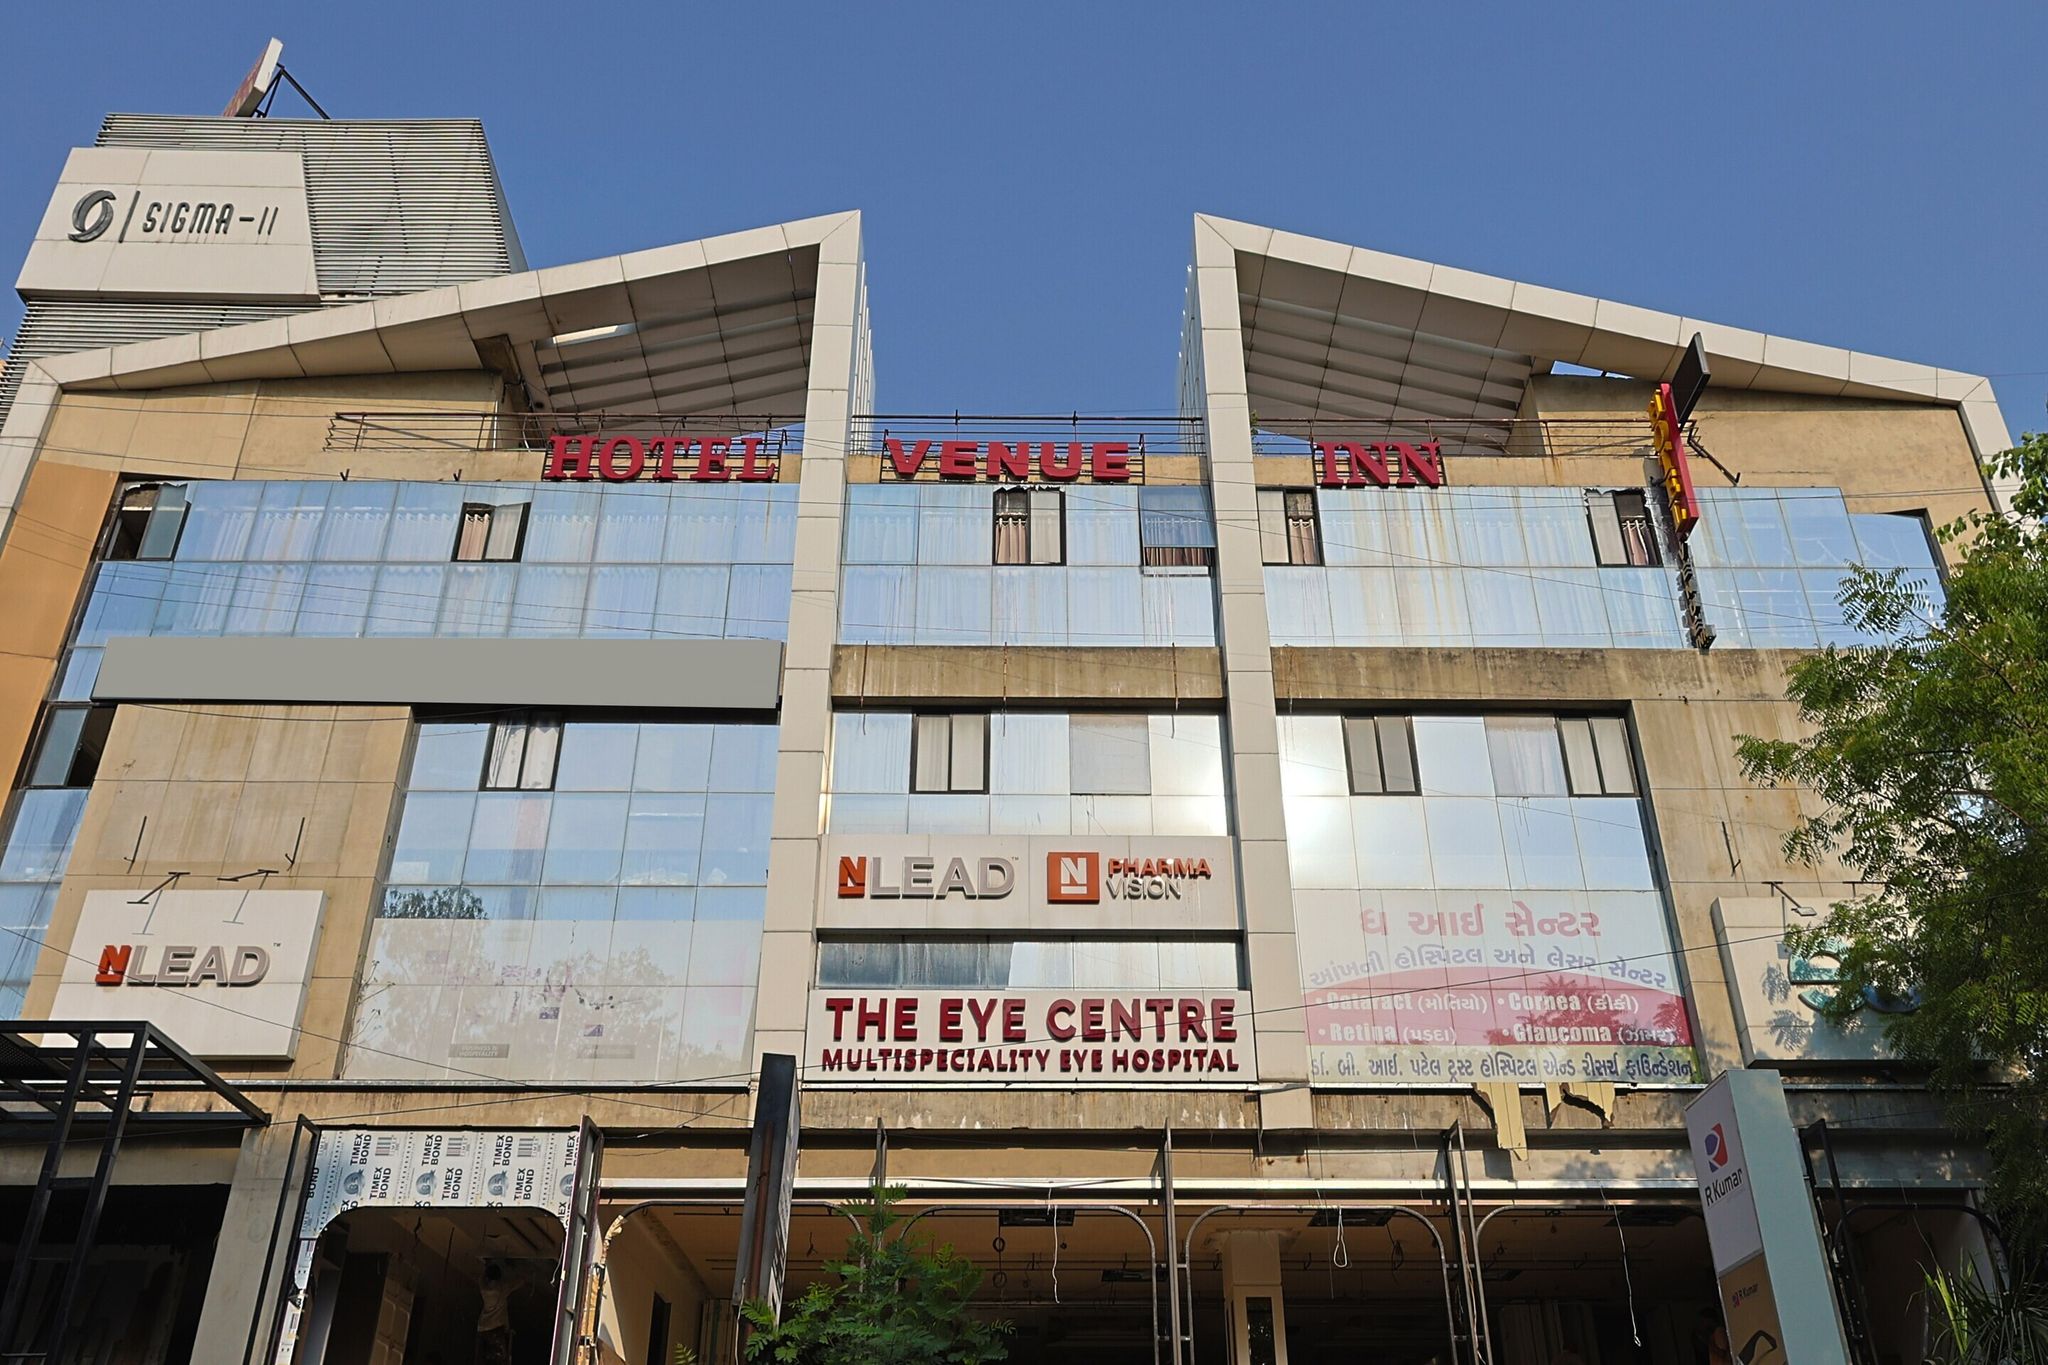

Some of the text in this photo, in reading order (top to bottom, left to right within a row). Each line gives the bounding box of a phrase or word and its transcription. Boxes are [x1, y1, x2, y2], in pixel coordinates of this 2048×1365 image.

[544, 434, 1441, 488] HOTEL VENUE INN
[837, 856, 1017, 901] NLEAD
[1108, 858, 1212, 880] PHARMA
[1106, 876, 1182, 900] VISION
[1408, 902, 1484, 937] આઈ
[1504, 900, 1602, 937] સેન્ટર
[95, 945, 271, 987] NLEAD
[1394, 943, 1483, 969] હોસ્પિટલ
[1494, 943, 1536, 965] અને
[1608, 956, 1667, 988] સેન્ટર
[1327, 991, 1414, 1010] Cataract
[1508, 992, 1581, 1011] Cornea
[826, 997, 1238, 1043] THE EYE CENTRE
[1330, 1023, 1398, 1041] Retina
[1513, 1022, 1612, 1042] Glaucoma
[822, 1047, 1239, 1073] MULTISPECIALITY EYE HOSPITAL
[1410, 1051, 1441, 1076] પટેલ
[1480, 1051, 1537, 1077] હોસ્પિટલ
[350, 1133, 363, 1167] TIMEX
[359, 1134, 372, 1165] BOND
[422, 1134, 434, 1166] TIMEX
[431, 1135, 443, 1165] BOND
[493, 1135, 505, 1167] TIMEX
[502, 1135, 514, 1166] BOND
[564, 1135, 576, 1167] TIMEX
[369, 1167, 383, 1199] TIMEX
[379, 1167, 391, 1199] BOND
[441, 1167, 454, 1200] TIMEX
[451, 1168, 463, 1199] BOND
[514, 1168, 526, 1200] TIMEX
[523, 1168, 535, 1200] BOND
[1704, 1168, 1743, 1207] R Kumar
